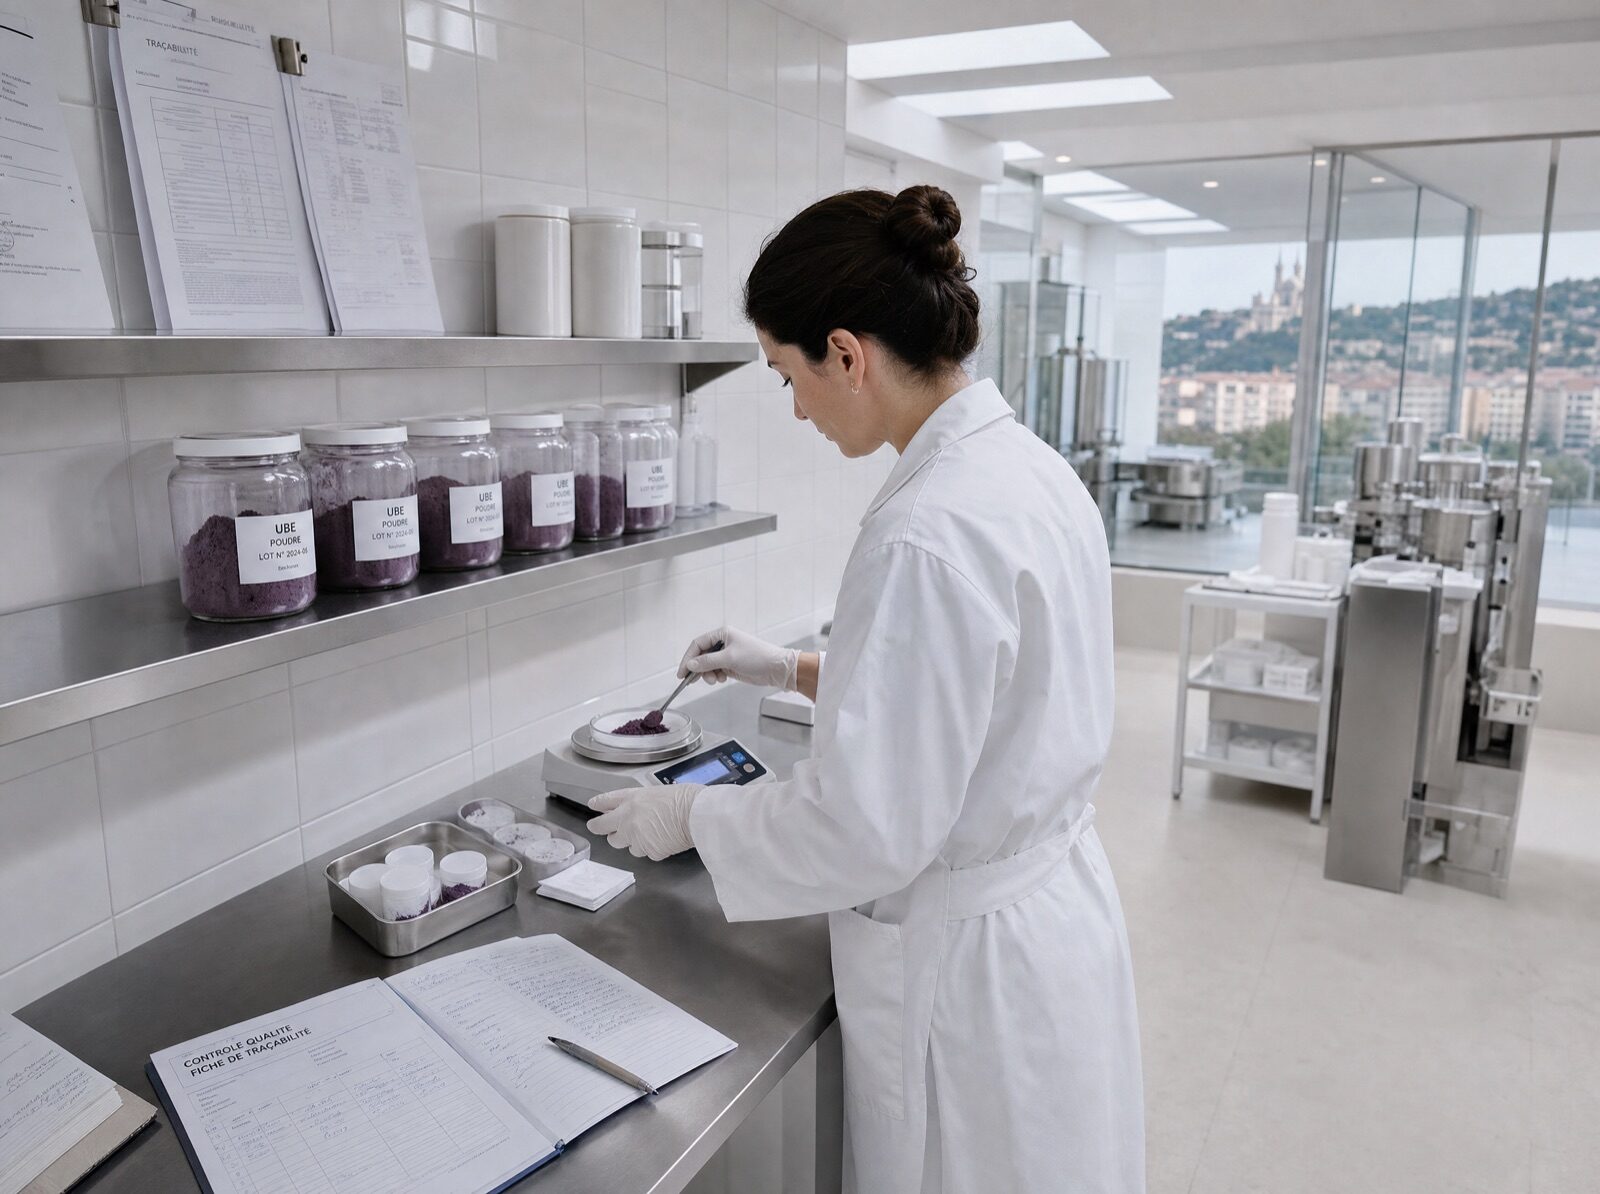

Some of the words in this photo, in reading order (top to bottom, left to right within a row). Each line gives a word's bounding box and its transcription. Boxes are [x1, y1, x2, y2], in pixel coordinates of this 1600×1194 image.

[479, 491, 493, 502] UBE
[387, 506, 405, 517] UBE
[275, 522, 297, 535] UBE
[382, 518, 408, 528] POUDRE
[270, 536, 302, 548] POUDRE
[372, 532, 385, 541] LOT
[258, 552, 274, 561] LOT
[183, 1041, 244, 1068] CONTROLE
[245, 1024, 293, 1046] QUALITE
[190, 1059, 226, 1077] FICHE
[227, 1052, 244, 1064] DE
[244, 1027, 312, 1058] TRAÇABILITÉ
